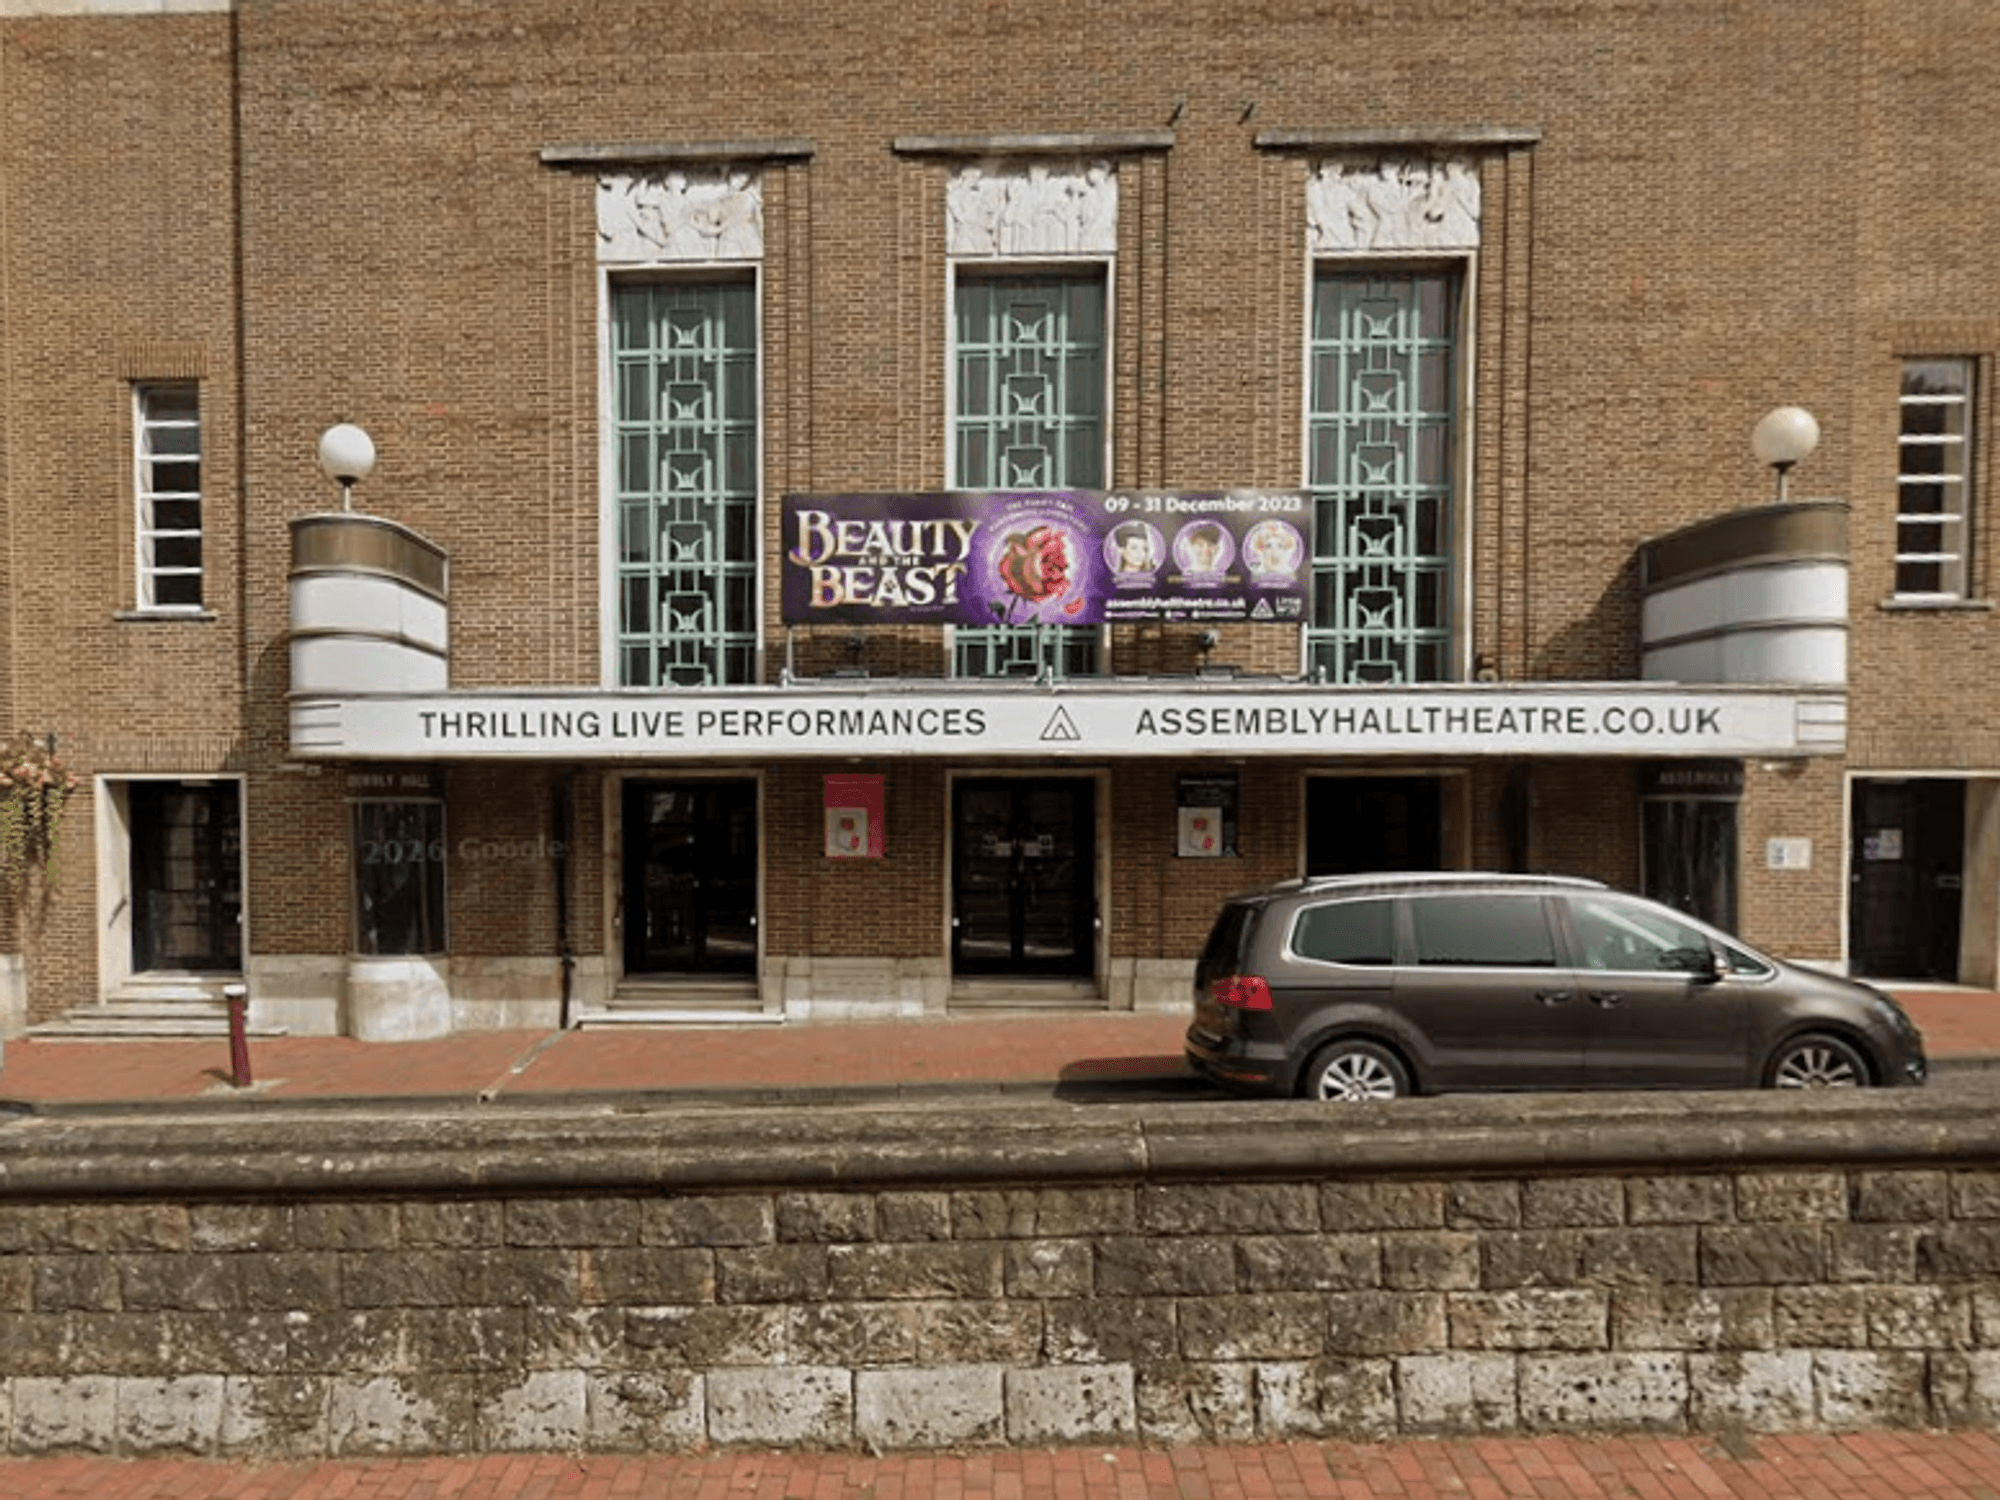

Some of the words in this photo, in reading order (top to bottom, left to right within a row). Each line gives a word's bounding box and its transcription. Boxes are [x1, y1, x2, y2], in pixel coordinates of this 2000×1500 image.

[1104, 496, 1130, 512] 09
[1144, 496, 1162, 512] 31
[1165, 495, 1253, 513] December
[1257, 496, 1303, 512] 2023
[788, 510, 982, 566] BEAUTY
[857, 557, 889, 567] AND
[893, 556, 920, 566] THE
[810, 563, 967, 608] BEAST
[419, 711, 600, 738] THRILLING
[612, 711, 684, 738] LIVE
[697, 708, 987, 737] PERFORMANCES
[1136, 707, 1721, 736] ASSEMBLYHALLTHEATRE.CO.UK
